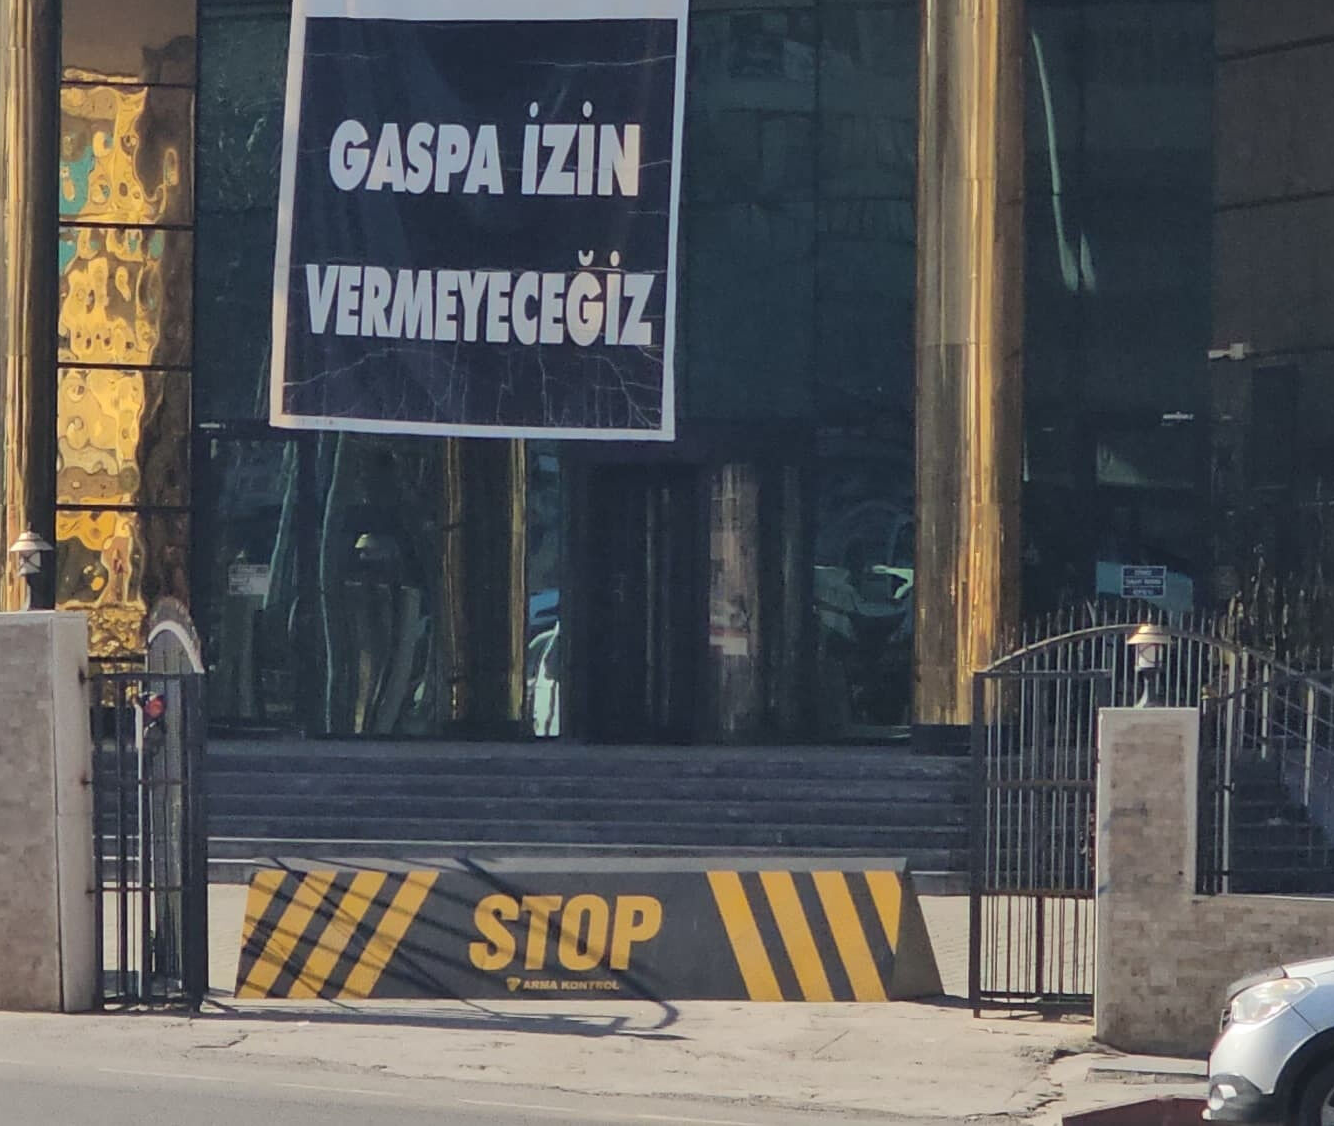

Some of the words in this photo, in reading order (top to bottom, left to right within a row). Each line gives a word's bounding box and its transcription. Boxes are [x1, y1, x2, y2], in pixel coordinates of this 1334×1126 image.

[328, 119, 504, 195] GASPA
[521, 101, 641, 197] İZİN
[305, 249, 656, 347] VERMEYECEĞİZ
[468, 893, 663, 971] STOP
[522, 979, 558, 991] ARMA
[561, 979, 620, 991] KONTROL
